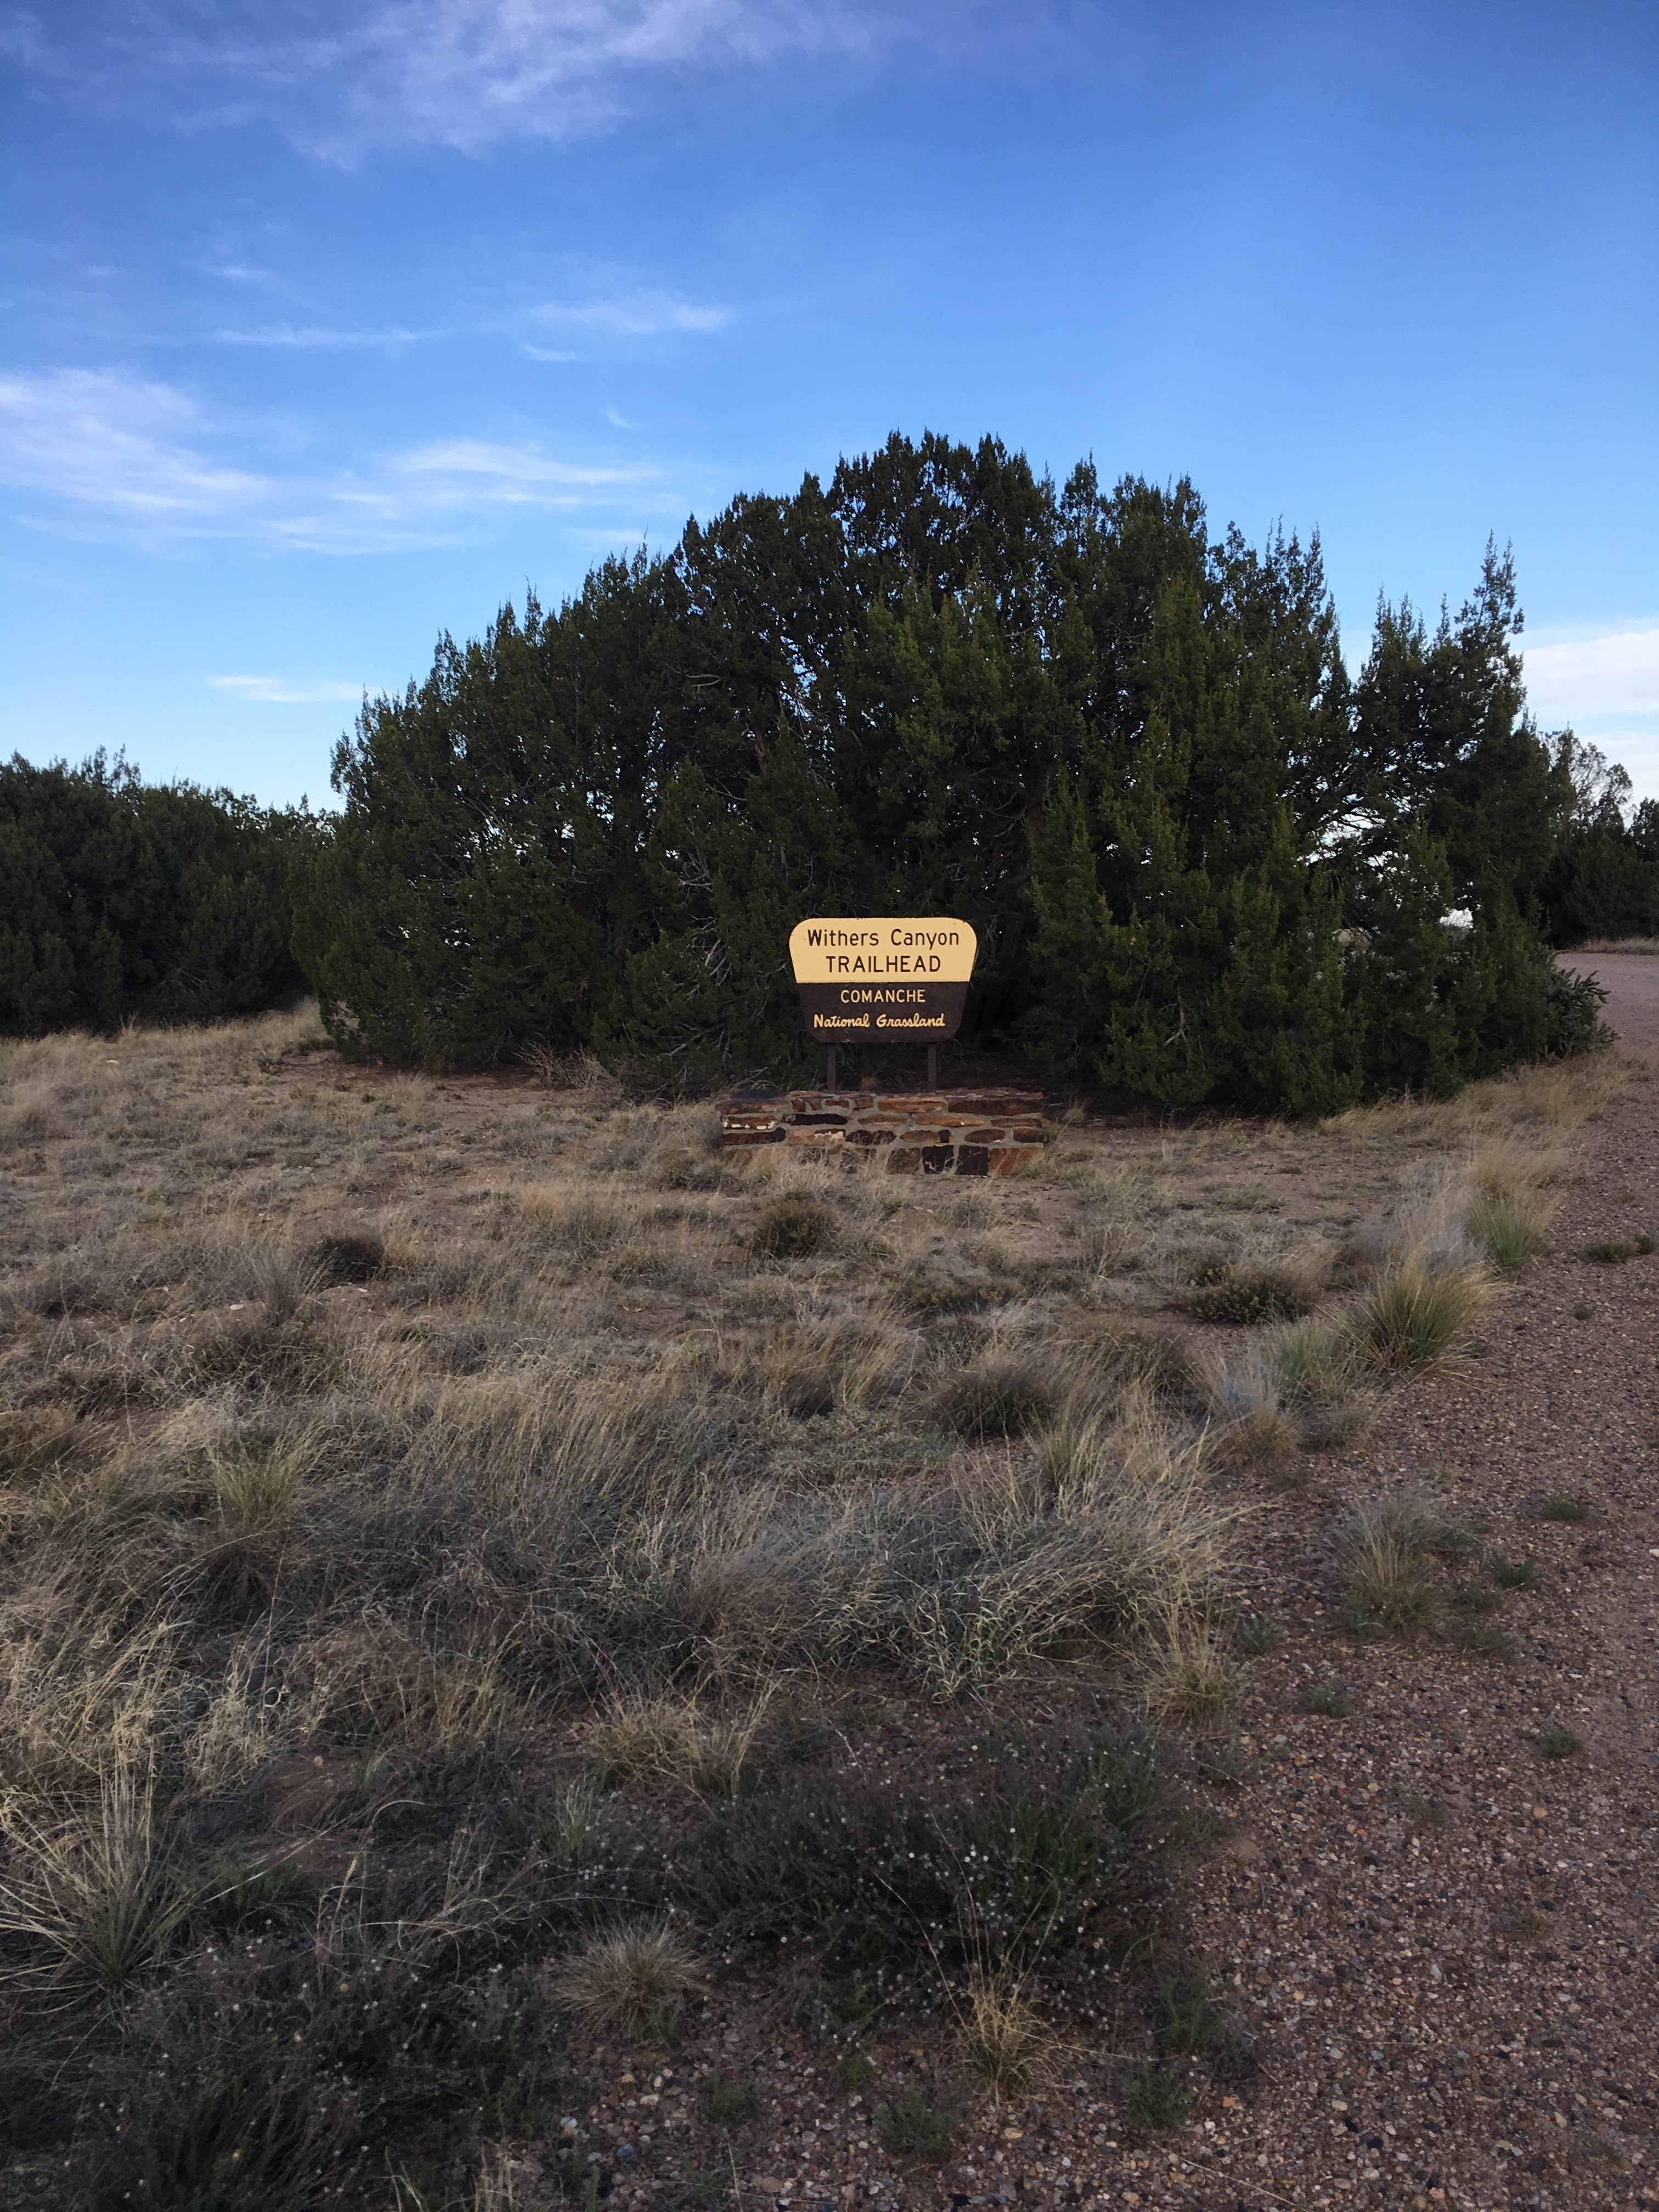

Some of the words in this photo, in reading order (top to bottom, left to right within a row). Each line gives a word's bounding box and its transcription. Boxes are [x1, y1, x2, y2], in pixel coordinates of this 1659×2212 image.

[808, 929, 879, 947] Withers
[890, 928, 959, 950] Canyon
[826, 955, 941, 973] TRAILHEAD
[840, 989, 926, 1004] COMANCHE
[814, 1013, 870, 1028] National
[876, 1013, 945, 1028] Grassland
